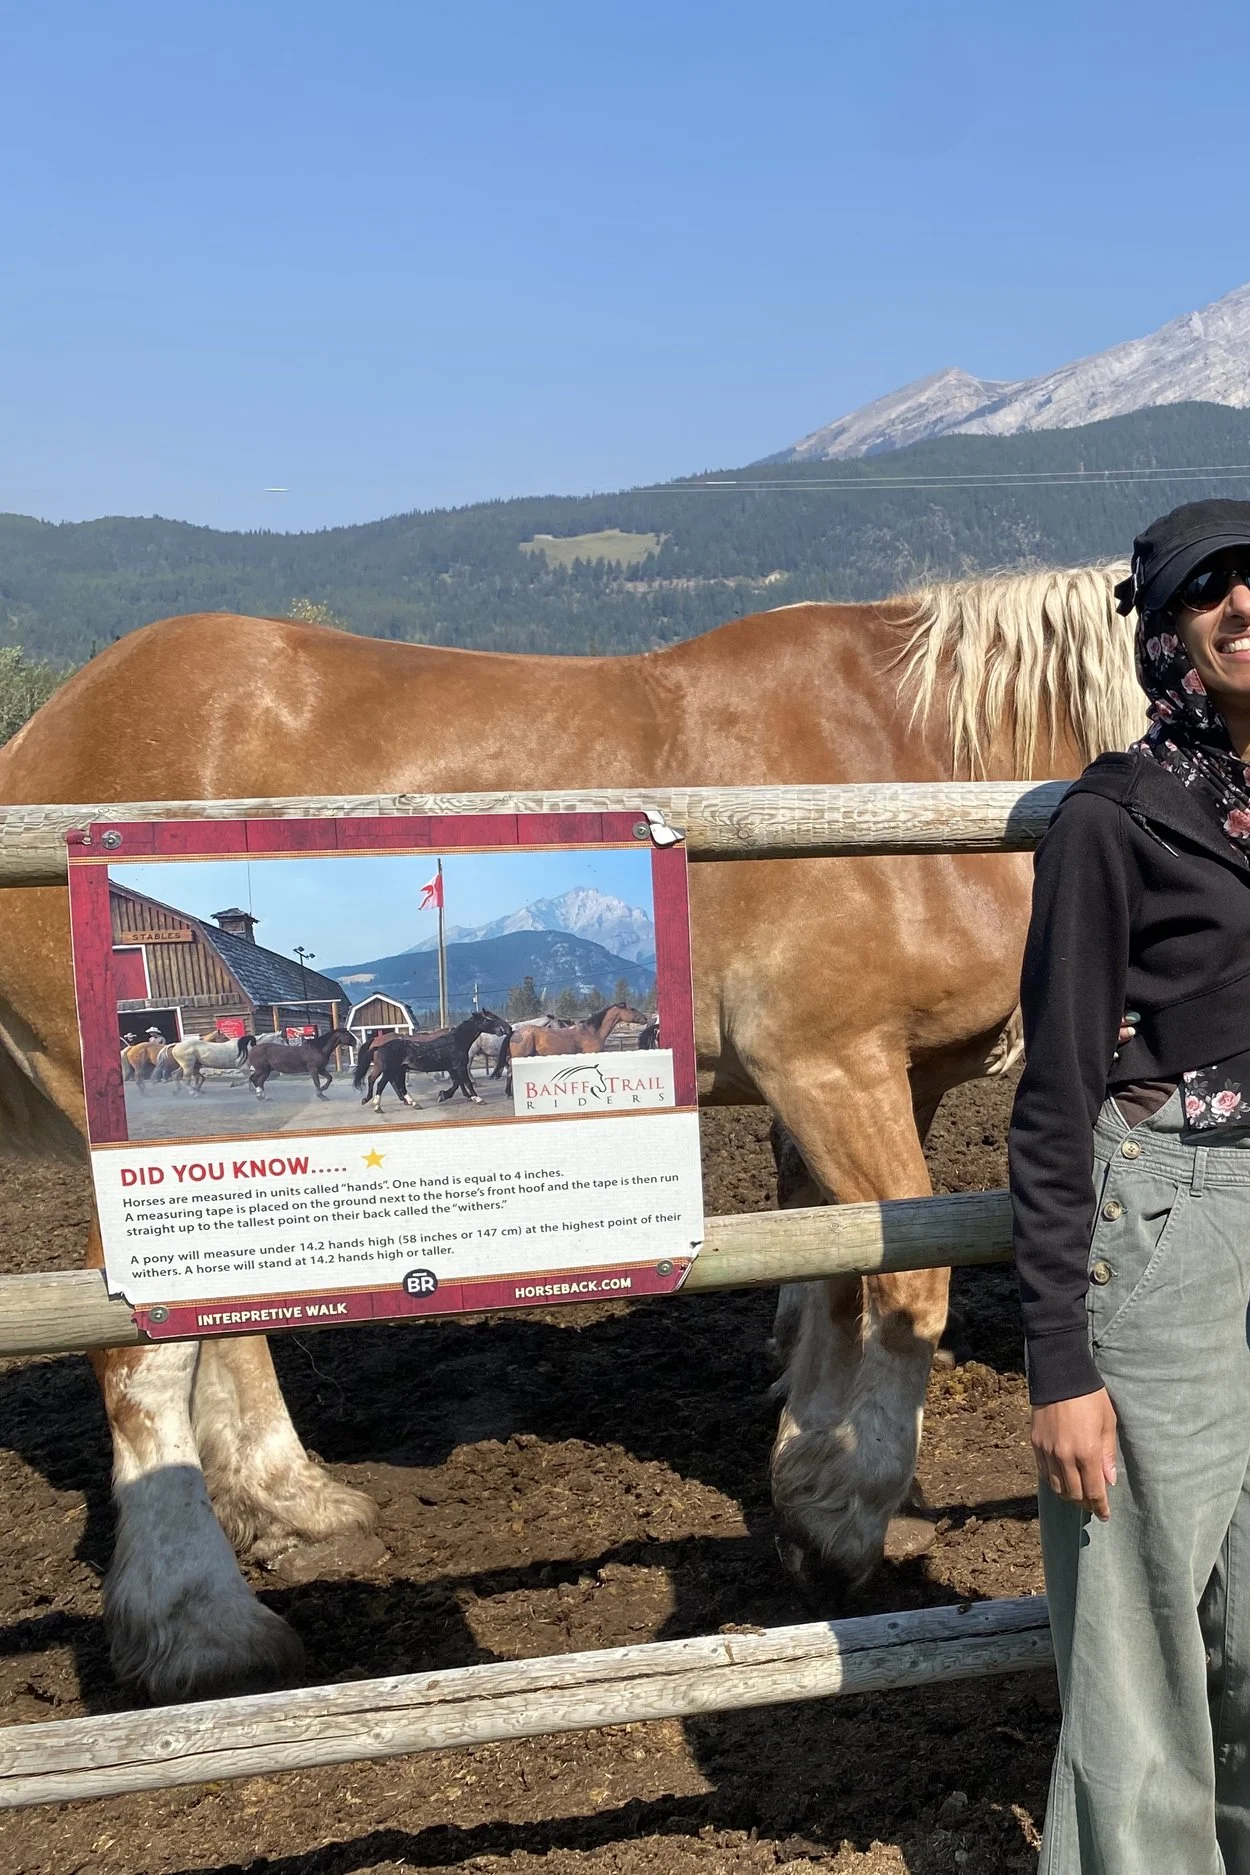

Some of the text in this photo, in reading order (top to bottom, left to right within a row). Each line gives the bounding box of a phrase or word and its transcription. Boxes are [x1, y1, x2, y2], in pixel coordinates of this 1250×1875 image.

[132, 932, 181, 940] STABLES
[525, 1076, 665, 1099] BANFF TRAIL
[526, 1093, 665, 1110] RIDERS
[121, 1167, 165, 1187] DID
[171, 1162, 225, 1183] YOU
[122, 1197, 166, 1208] Horses
[168, 1196, 189, 1205] are
[191, 1189, 253, 1201] measured
[255, 1189, 267, 1199] in
[270, 1187, 301, 1198] units
[303, 1183, 339, 1195] called
[392, 1179, 417, 1189] One
[419, 1175, 449, 1187] hand
[452, 1175, 462, 1185] is
[464, 1172, 497, 1185] equal
[499, 1173, 512, 1181] to
[514, 1171, 521, 1180] 4
[524, 1169, 564, 1180] inches.
[124, 1212, 135, 1223] A
[136, 1208, 203, 1222] measuring
[205, 1207, 234, 1218] tape
[236, 1204, 247, 1214] is
[248, 1201, 289, 1214] placed
[291, 1202, 308, 1210] on
[309, 1199, 331, 1209] the
[332, 1195, 377, 1208] ground
[379, 1194, 406, 1204] next
[407, 1193, 421, 1202] to
[423, 1191, 443, 1201] the
[487, 1186, 516, 1196] front
[518, 1182, 545, 1194] hoof
[547, 1181, 569, 1192] and
[571, 1180, 591, 1190] the
[592, 1179, 619, 1189] tape
[620, 1178, 630, 1186] is
[631, 1175, 658, 1185] then
[660, 1174, 679, 1183] run
[126, 1224, 176, 1237] straight
[178, 1224, 195, 1235] up
[197, 1222, 211, 1231] to
[213, 1219, 235, 1230] the
[237, 1217, 275, 1229] tallest
[277, 1214, 311, 1228] point
[313, 1214, 329, 1223] on
[331, 1210, 361, 1221] their
[362, 1207, 391, 1219] back
[393, 1205, 429, 1217] called
[431, 1204, 451, 1214] the
[130, 1212, 682, 1266] A pony will measure under 14.2 hands high (58 inches or 147 cm) at the highest point of their
[131, 1245, 455, 1279] withers. A horse will stand at 14.2 hands high or taller.
[406, 1274, 436, 1293] BR
[515, 1277, 632, 1299] HORSEBACK.COM
[197, 1302, 348, 1327] INTERPRETIVE WALK
